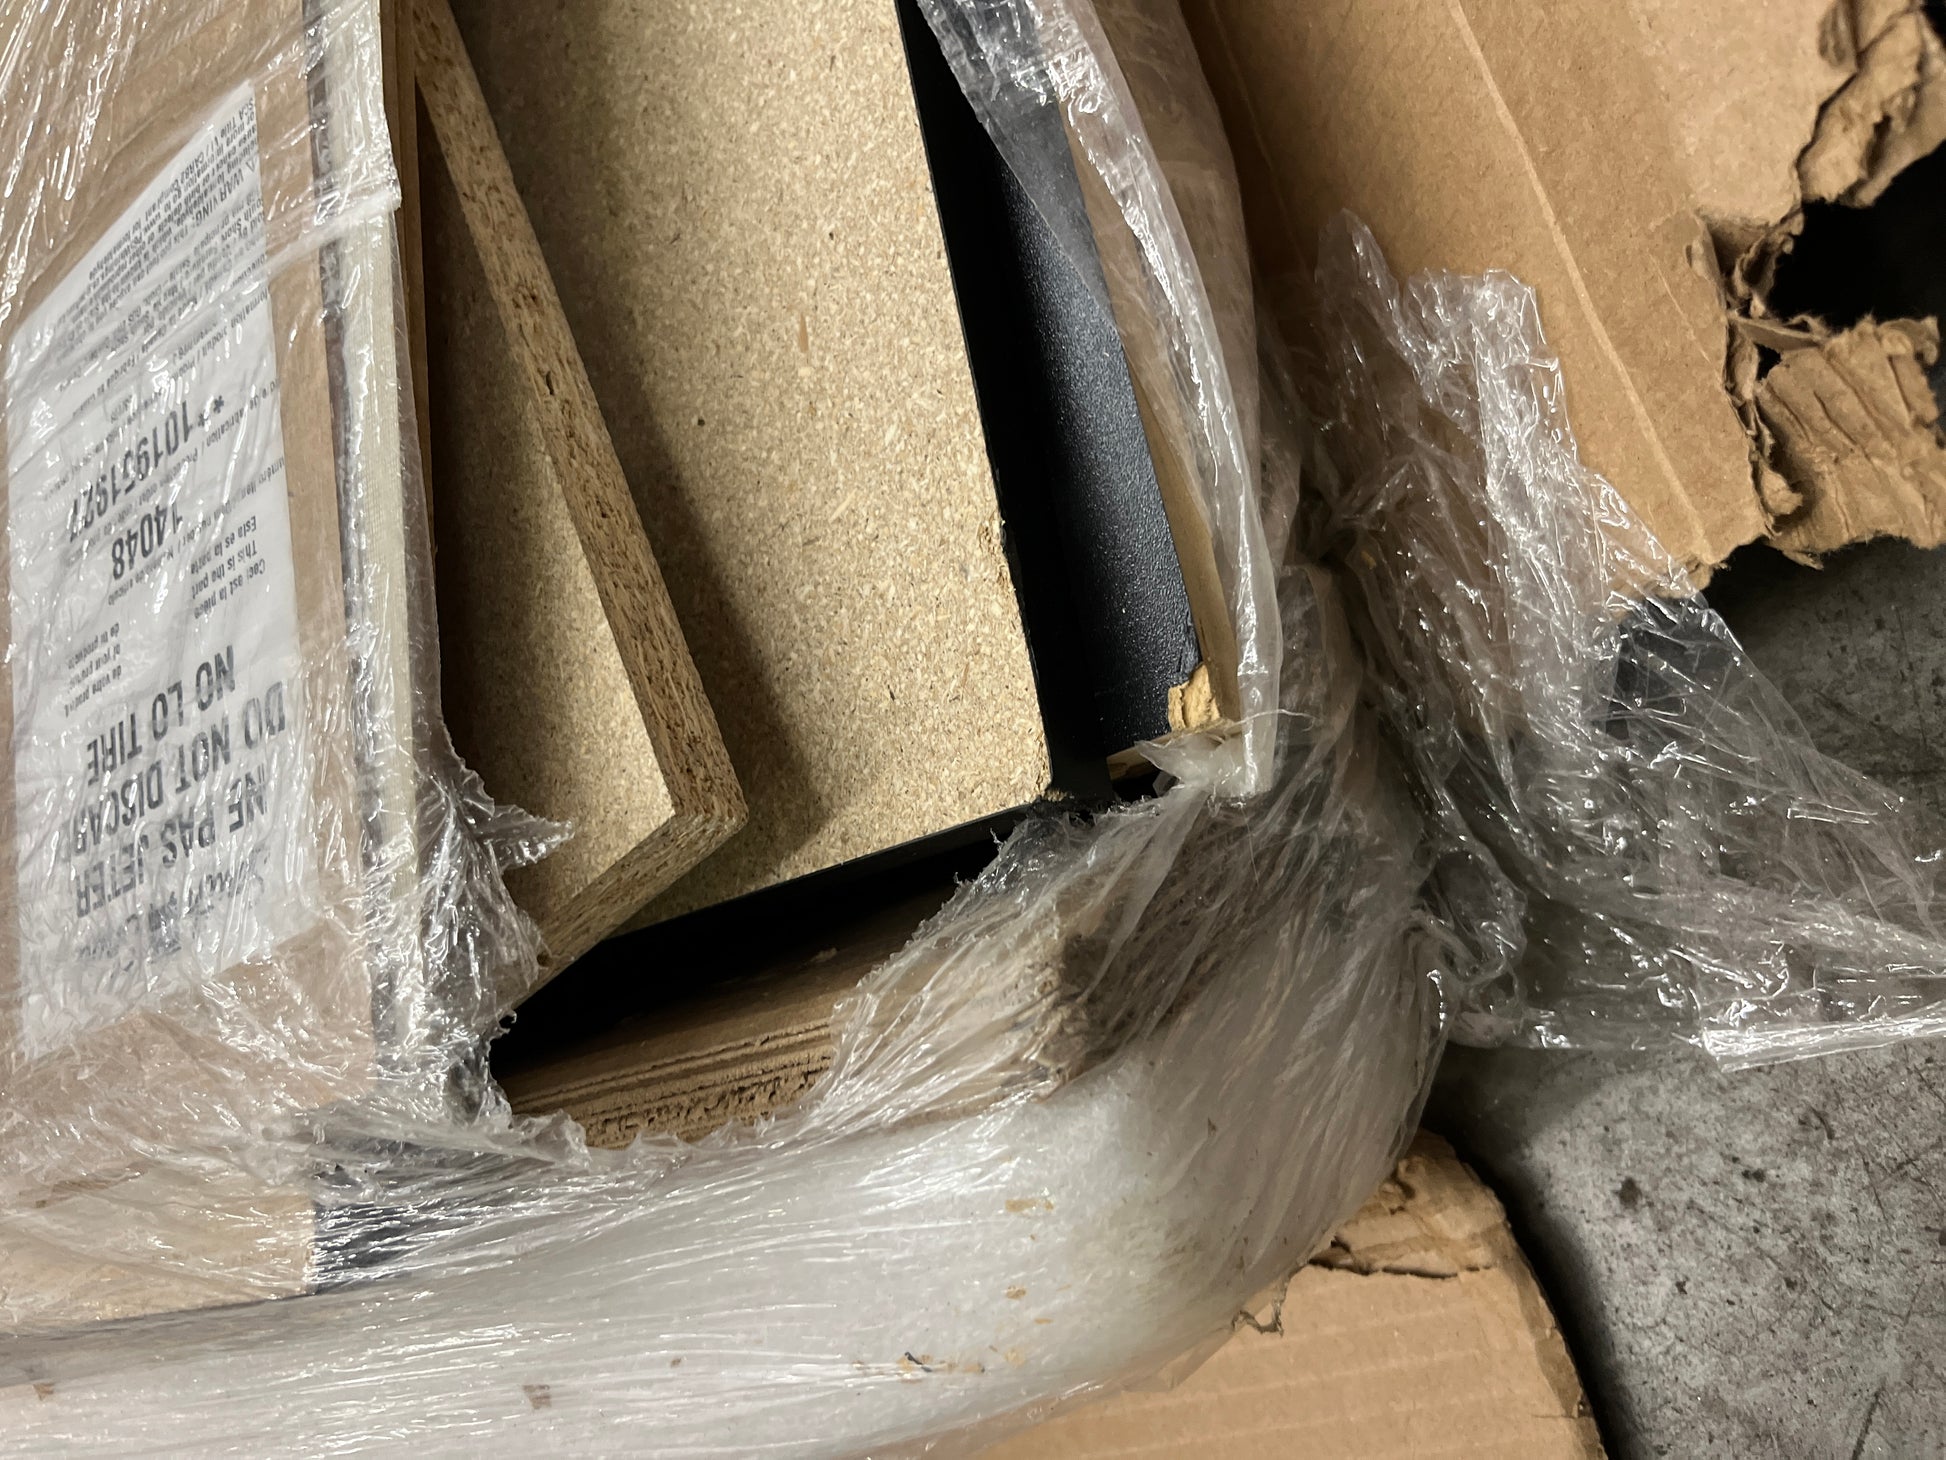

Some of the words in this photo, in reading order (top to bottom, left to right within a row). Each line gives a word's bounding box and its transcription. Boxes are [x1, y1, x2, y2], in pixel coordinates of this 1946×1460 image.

[238, 94, 254, 123] SCA
[246, 109, 254, 128] or
[238, 122, 255, 149] ause
[226, 134, 256, 179] ncluding
[191, 164, 243, 232] WARNING:
[243, 194, 262, 225] outh
[249, 208, 264, 236] old
[206, 400, 248, 451] abrication
[258, 454, 285, 490] uméro
[111, 484, 182, 585] 14048
[224, 530, 234, 550] es
[237, 513, 256, 542] Esta
[214, 540, 222, 561] la
[227, 554, 234, 575] is
[237, 538, 256, 567] This
[191, 570, 208, 601] part
[211, 561, 224, 587] the
[229, 572, 242, 597] est
[246, 555, 265, 585] Ceci
[218, 584, 226, 604] la
[196, 640, 234, 716] NO
[152, 677, 182, 747] LO
[244, 677, 284, 756] DO
[86, 706, 141, 789] TIRE
[175, 713, 229, 797] NOT
[229, 765, 266, 833] NE
[161, 795, 215, 873] PAS
[75, 833, 148, 921] JETER
